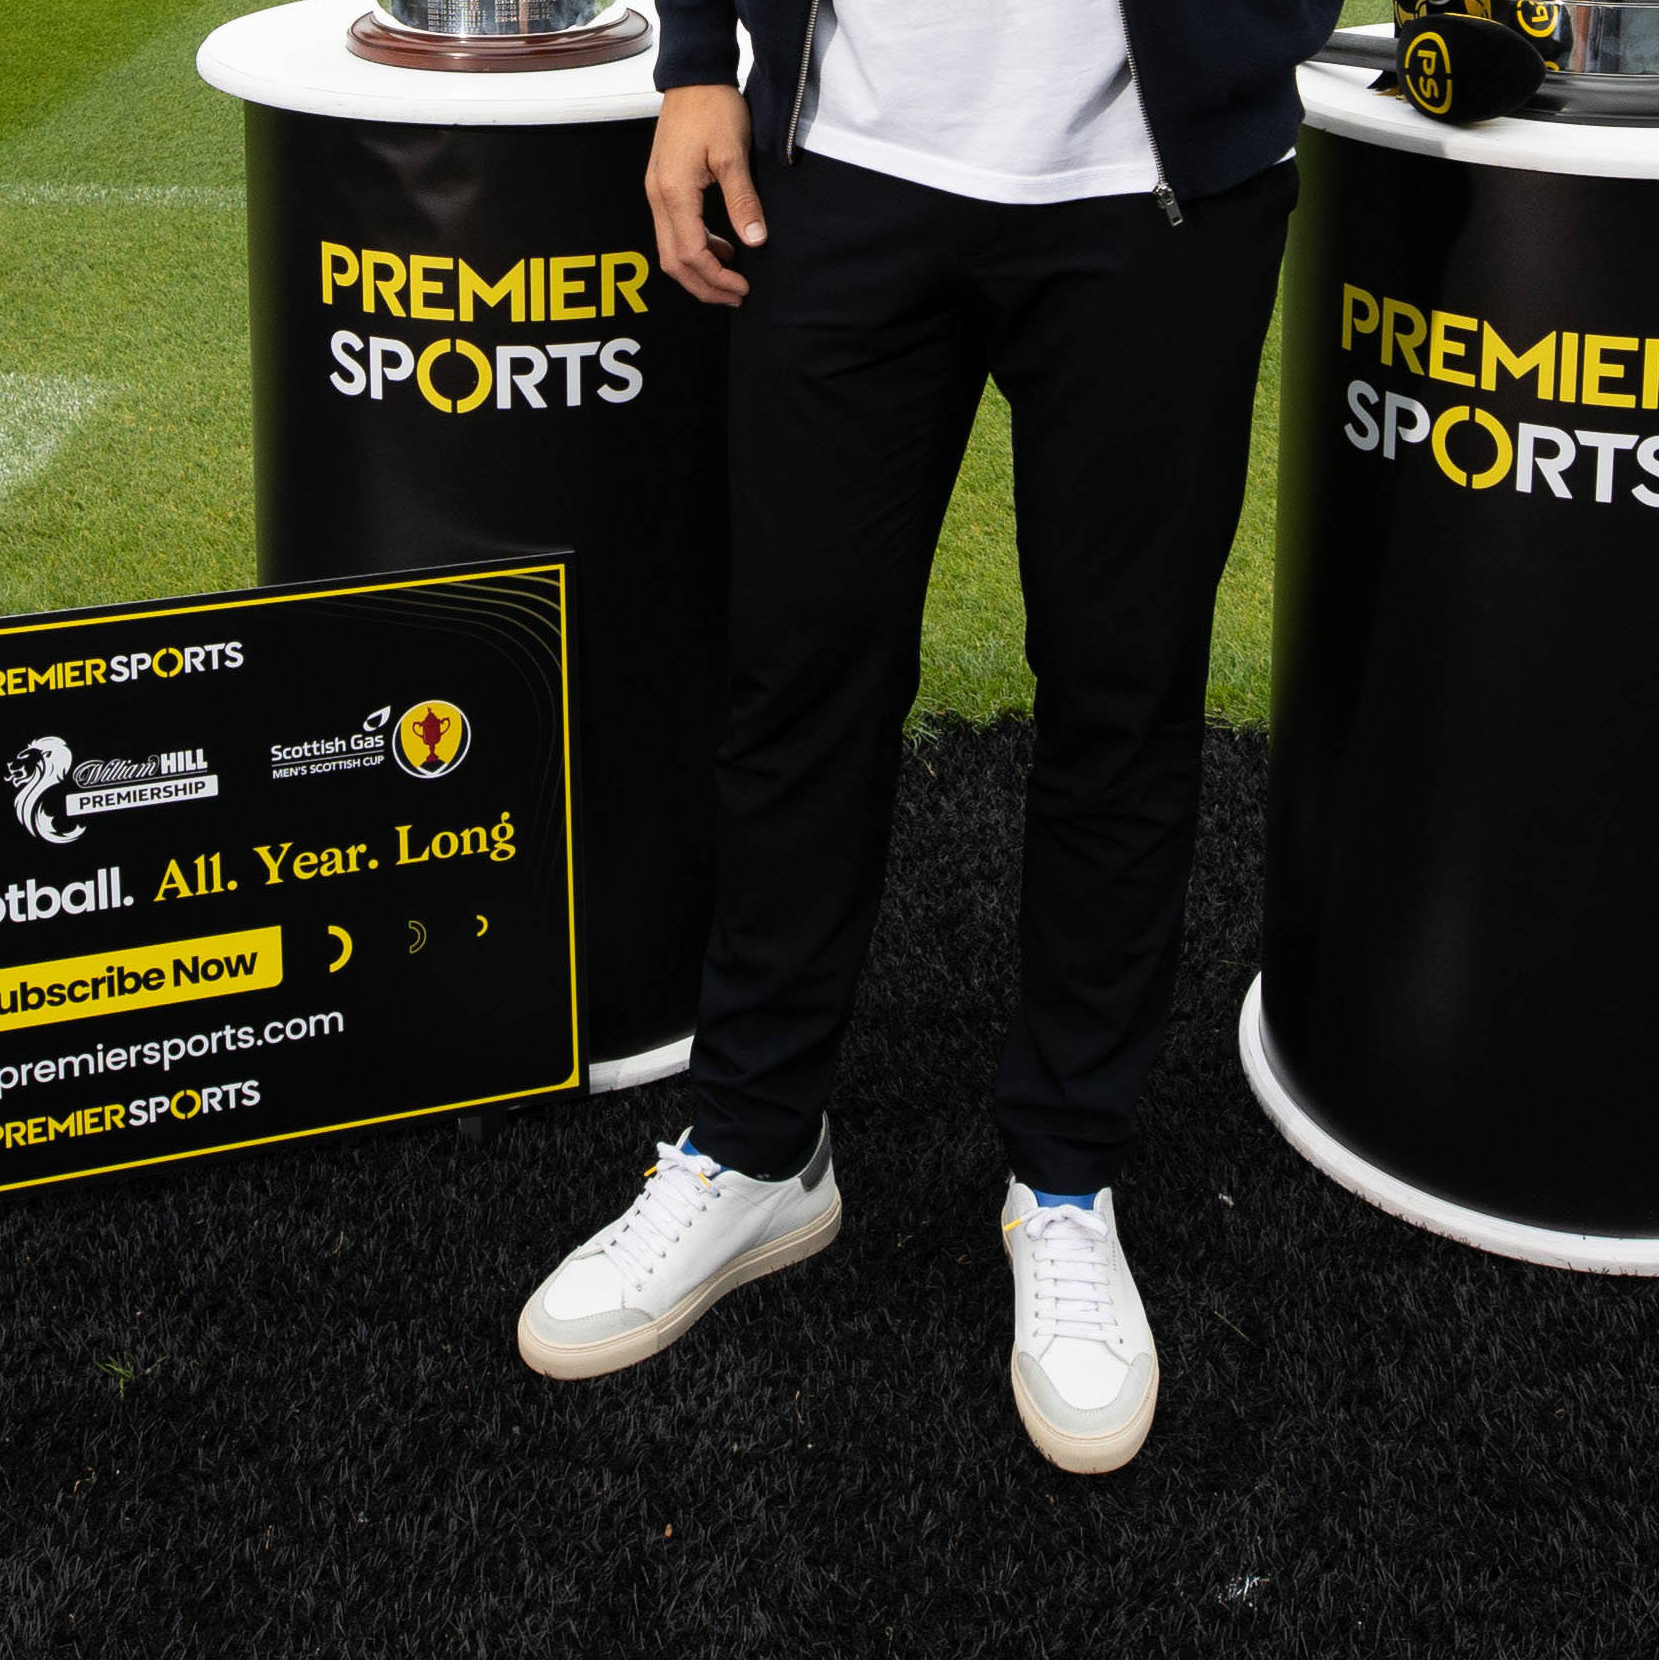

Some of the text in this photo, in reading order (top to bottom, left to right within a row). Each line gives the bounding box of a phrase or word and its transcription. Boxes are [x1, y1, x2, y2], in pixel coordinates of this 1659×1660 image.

[1417, 50, 1440, 100] PS
[321, 241, 650, 322] PREMIER
[329, 330, 643, 415] SPORTS
[271, 734, 385, 761] Scottish Gas
[272, 755, 385, 780] MEN'S SCOTTISH CUP
[73, 748, 207, 788] William HILL
[79, 781, 207, 811] PREMIERSHIP
[153, 852, 238, 902] All.
[253, 842, 379, 886] Year.
[395, 811, 517, 863] Long
[172, 951, 258, 988] Now
